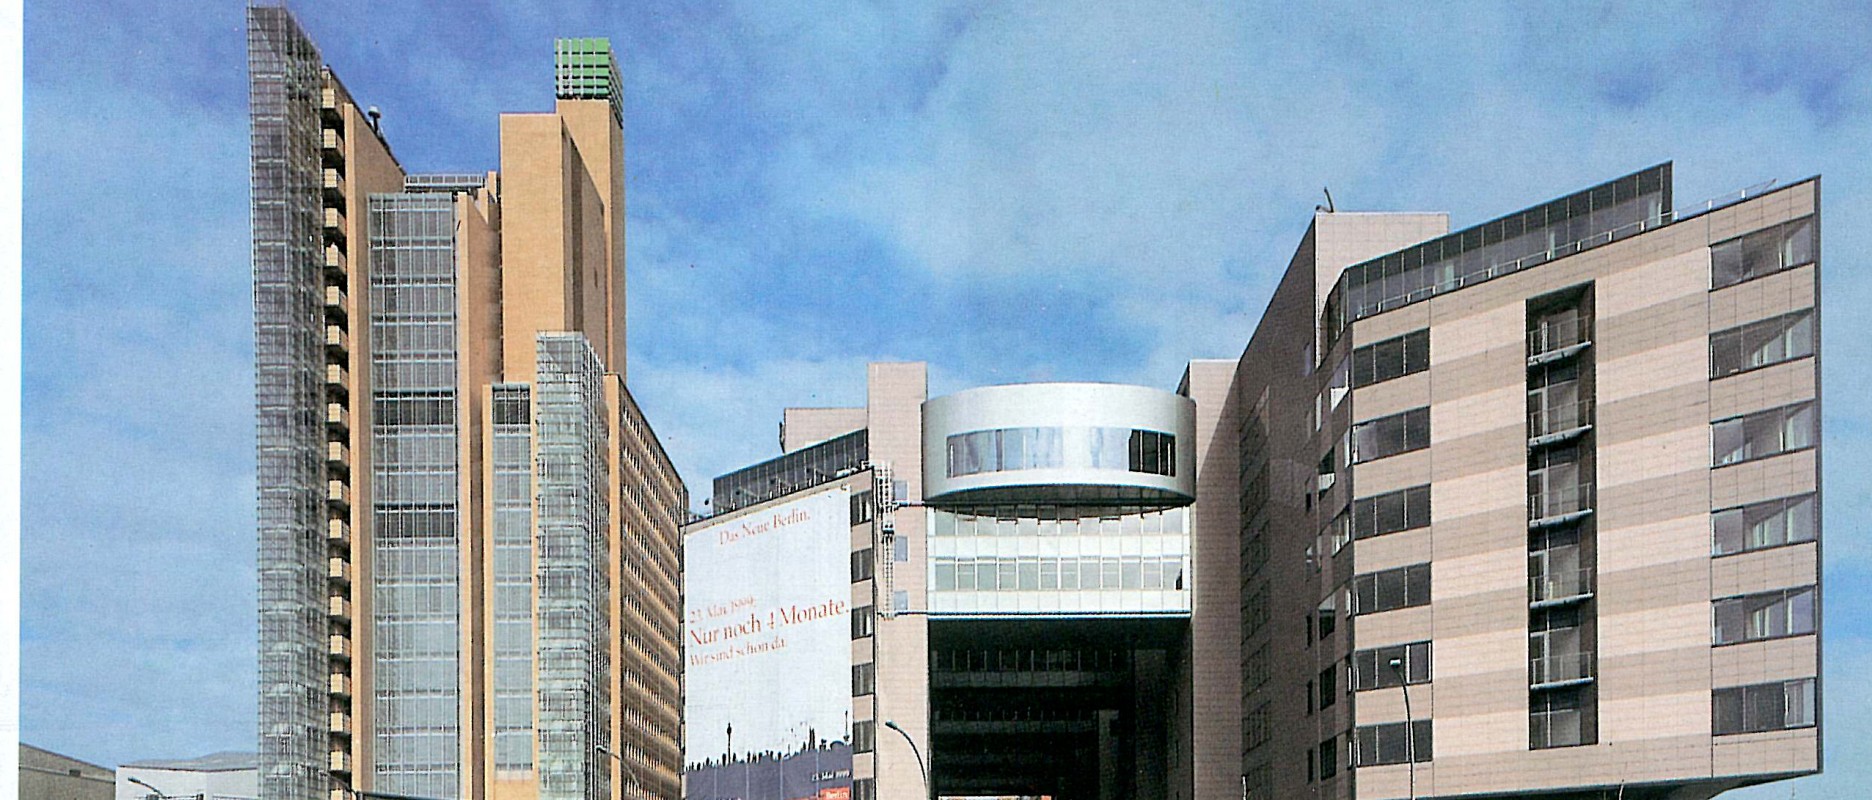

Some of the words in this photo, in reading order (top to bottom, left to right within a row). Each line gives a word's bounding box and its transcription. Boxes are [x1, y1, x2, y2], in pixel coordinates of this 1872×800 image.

[720, 530, 739, 545] Das
[742, 521, 770, 538] Neue
[773, 508, 811, 529] Berlin.
[690, 627, 719, 647] Nur
[724, 612, 762, 640] noch
[780, 598, 850, 626] Monate.
